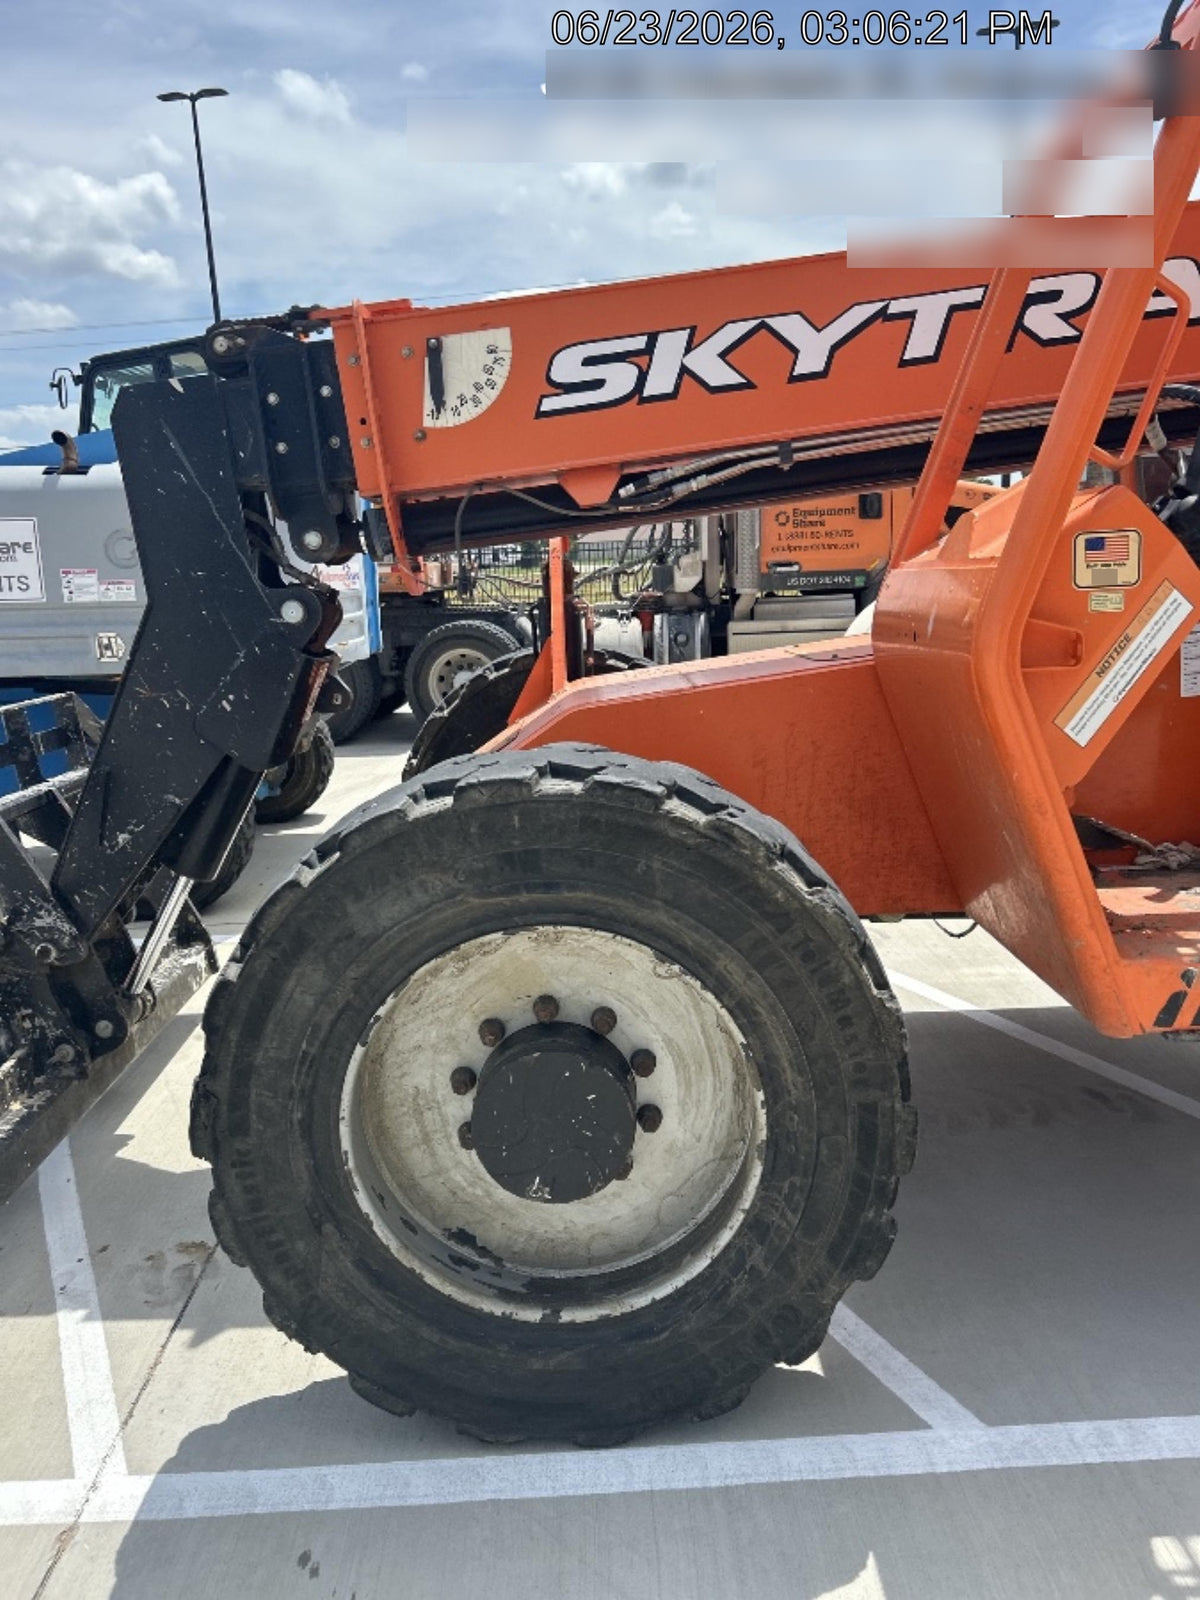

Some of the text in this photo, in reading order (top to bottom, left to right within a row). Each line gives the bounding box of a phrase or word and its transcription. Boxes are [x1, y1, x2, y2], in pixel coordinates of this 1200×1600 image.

[792, 506, 857, 519] Equipment
[792, 518, 826, 529] Share
[1095, 632, 1133, 678] NOTICE
